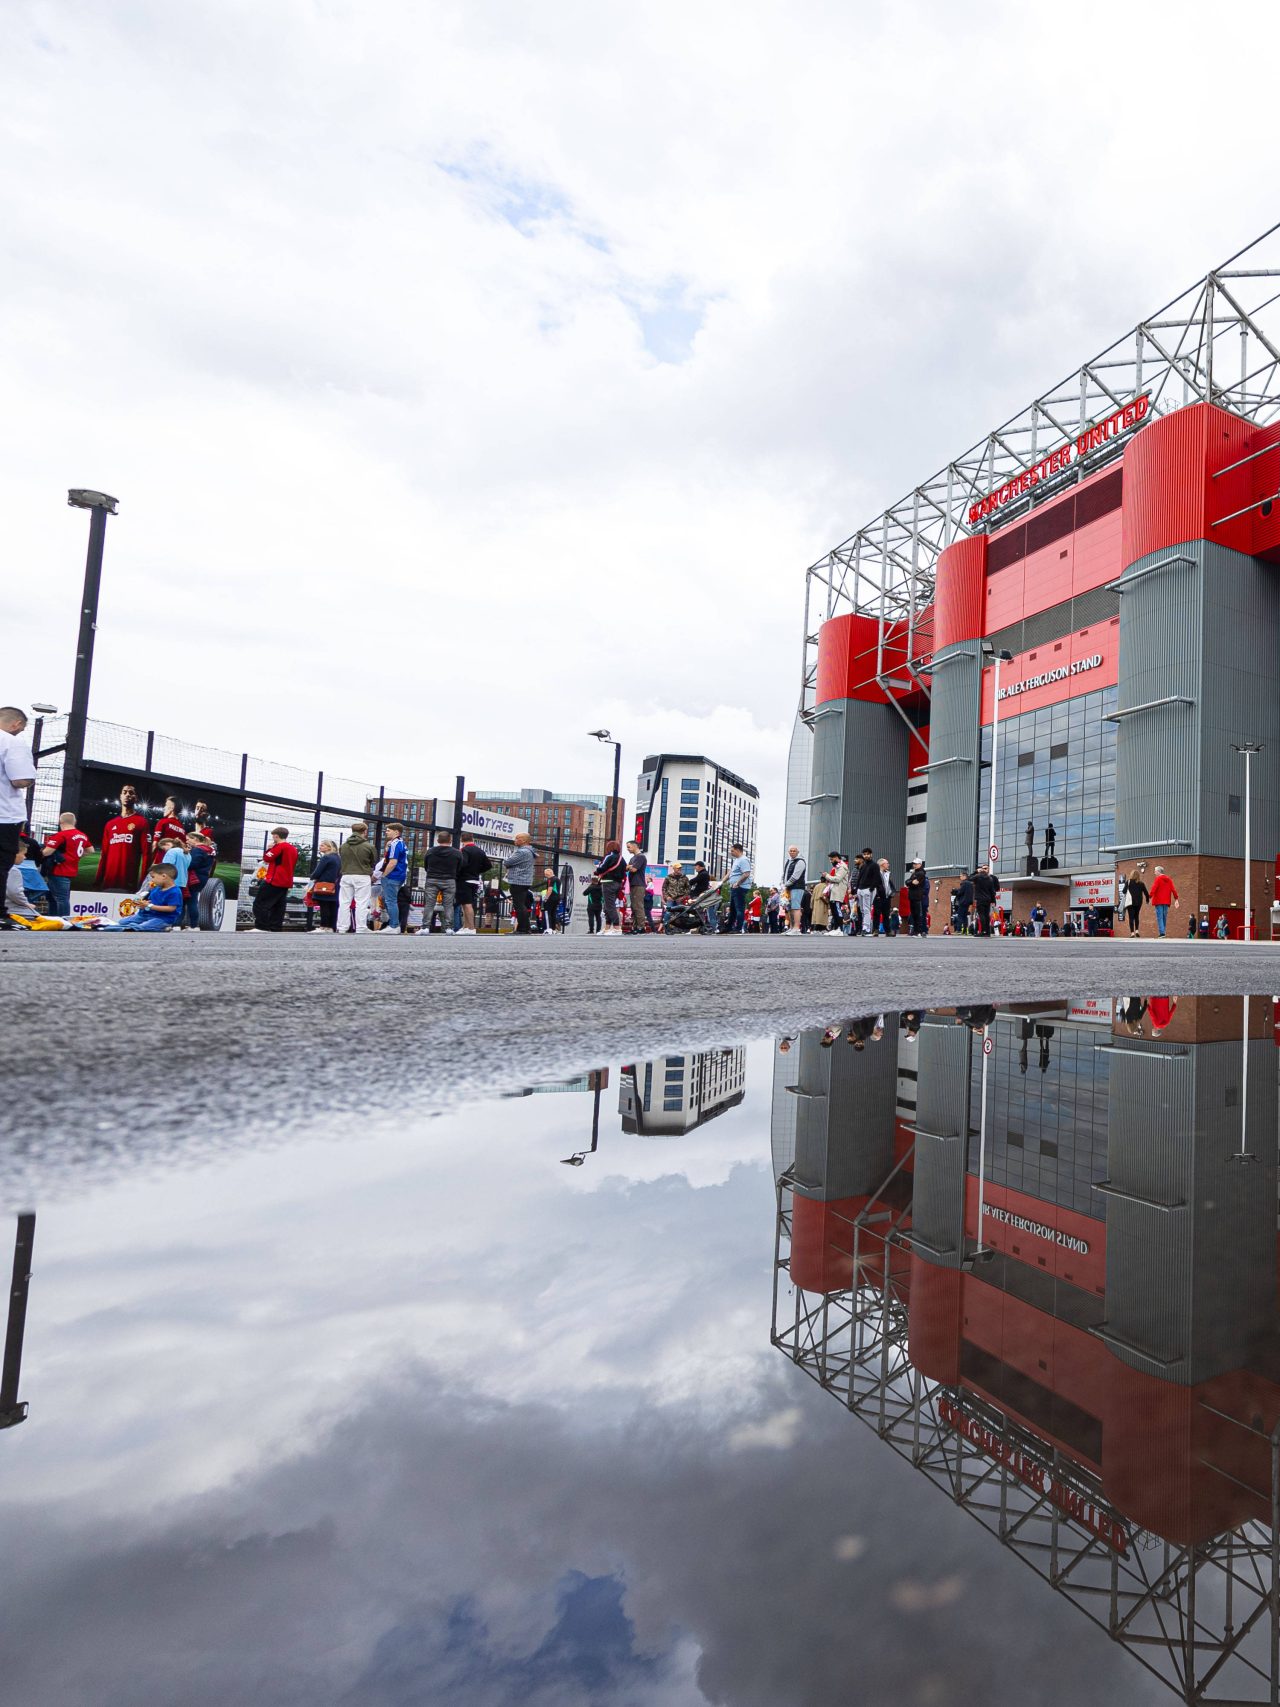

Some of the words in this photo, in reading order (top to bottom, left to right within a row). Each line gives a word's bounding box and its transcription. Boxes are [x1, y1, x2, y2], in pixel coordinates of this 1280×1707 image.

[968, 444, 1071, 524] MANCHESTER
[1077, 395, 1149, 456] UNITED
[998, 689, 1006, 699] IR
[1007, 680, 1026, 697] ALEX
[1026, 666, 1070, 690] FERGUSON
[1071, 655, 1103, 675] STAND
[461, 810, 485, 828] pollo
[485, 818, 514, 833] TYRES
[77, 841, 84, 857] 6
[992, 849, 996, 858] 5
[73, 902, 108, 916] apollo
